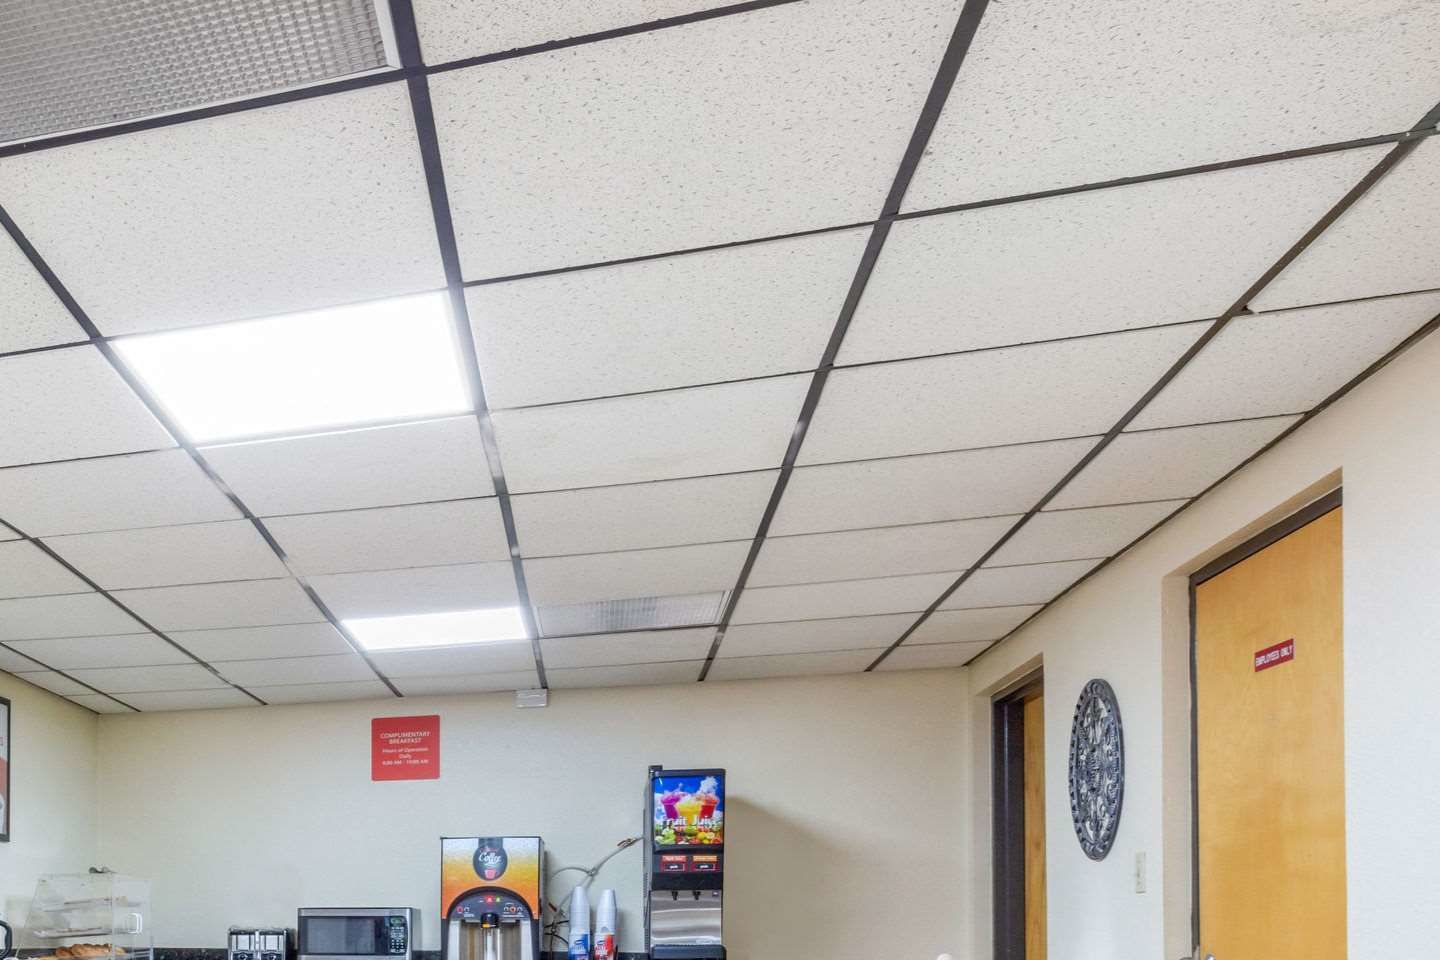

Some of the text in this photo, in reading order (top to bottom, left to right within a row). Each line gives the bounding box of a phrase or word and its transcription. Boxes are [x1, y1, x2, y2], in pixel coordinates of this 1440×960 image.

[1255, 645, 1293, 667] EMPLOYEES ONLY
[380, 731, 430, 739] COMPLIMENTARY
[478, 852, 502, 865] Coffee
